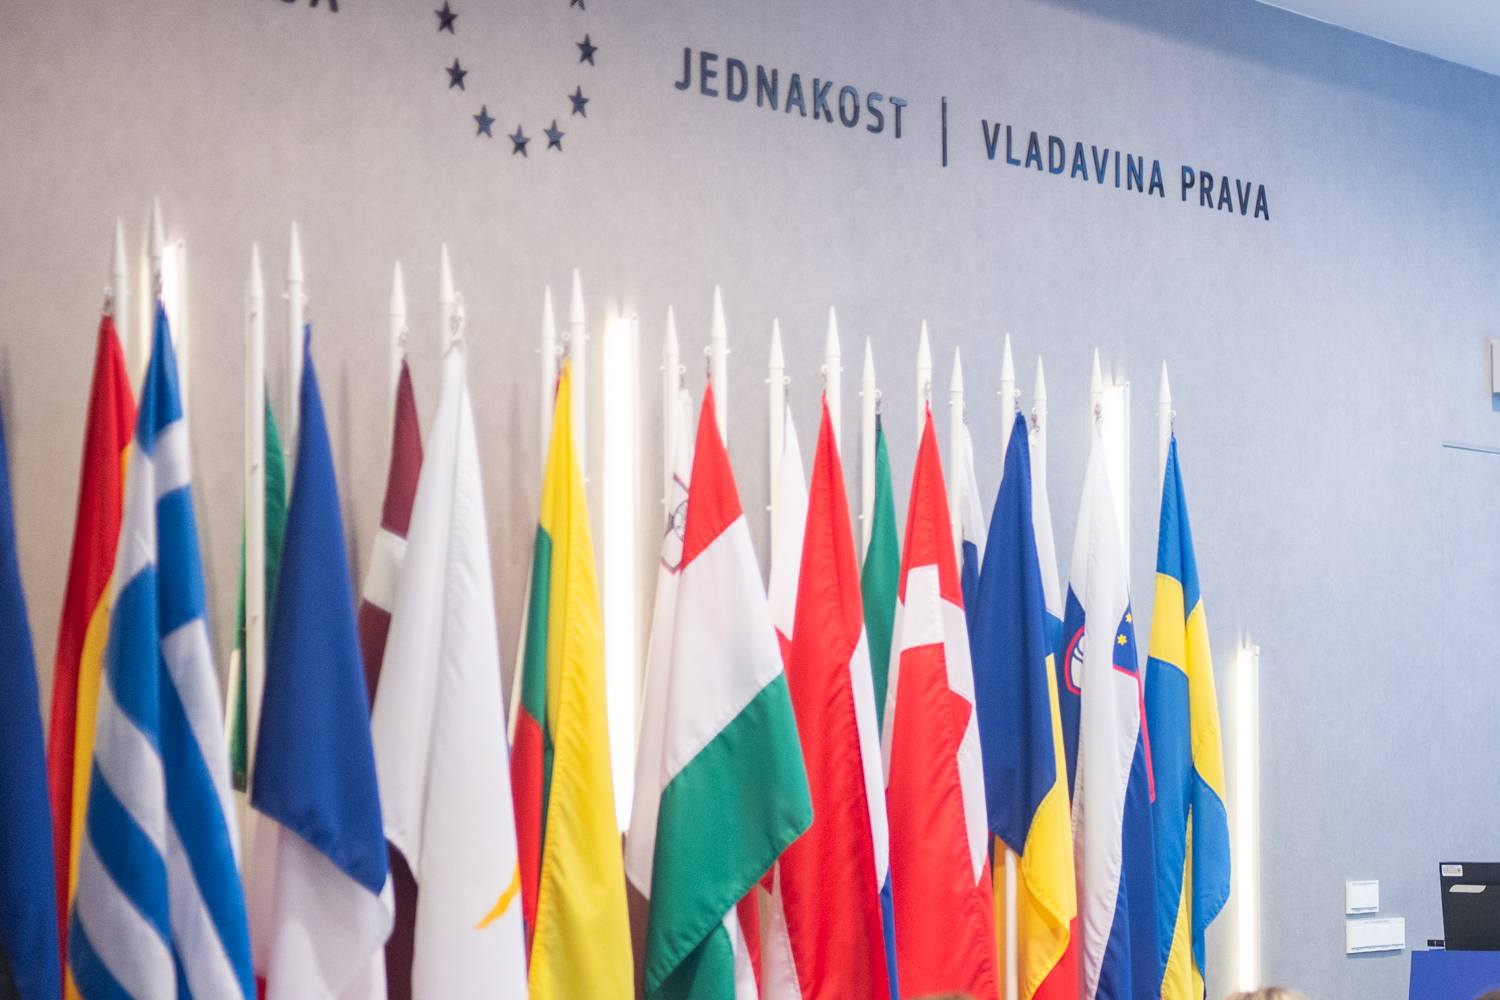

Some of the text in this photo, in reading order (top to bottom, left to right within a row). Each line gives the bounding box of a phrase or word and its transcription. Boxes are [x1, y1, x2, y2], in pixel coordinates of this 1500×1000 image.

[674, 47, 1270, 221] JEDNAKOST VLADAVINA PRAVA
